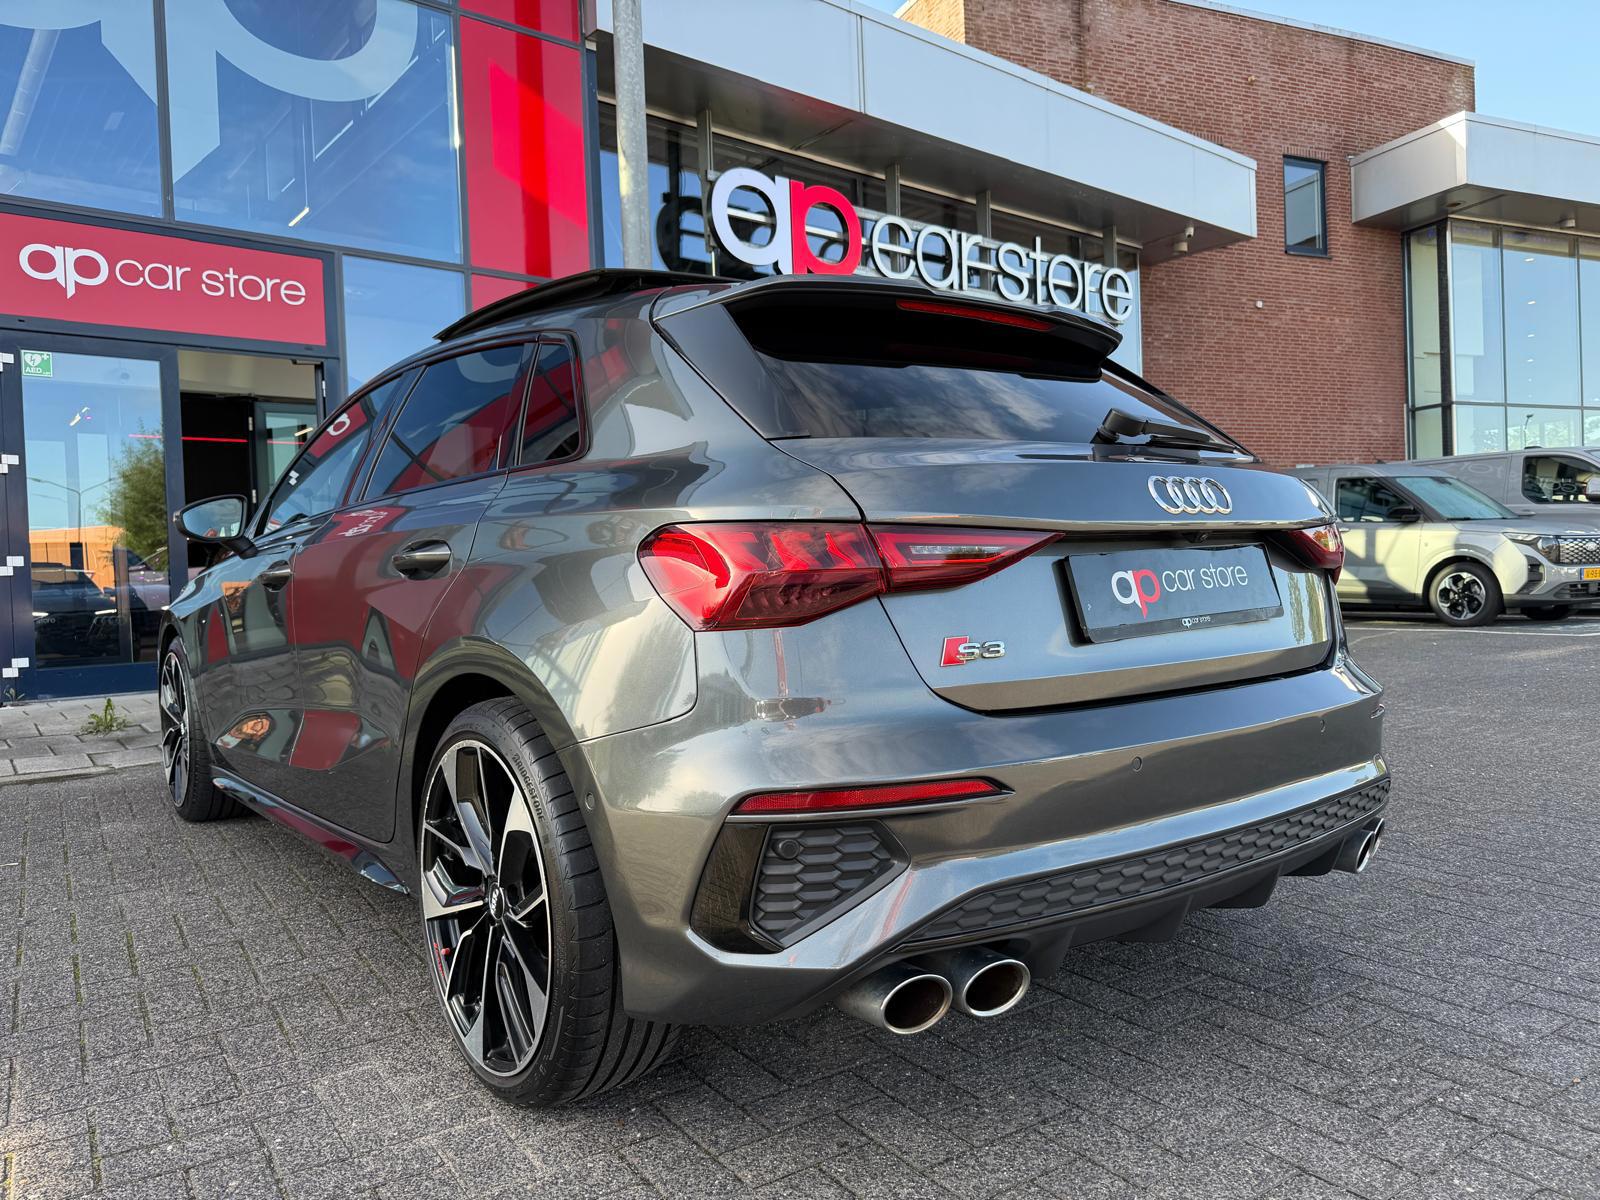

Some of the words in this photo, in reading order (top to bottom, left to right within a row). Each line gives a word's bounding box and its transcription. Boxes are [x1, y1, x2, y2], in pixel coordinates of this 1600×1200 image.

[711, 167, 863, 276] ap
[871, 214, 984, 291] car
[996, 235, 1135, 322] store
[18, 243, 110, 300] ap
[115, 258, 192, 292] car
[201, 266, 307, 306] store
[25, 366, 43, 374] AED
[1110, 568, 1162, 620] ap
[1161, 568, 1197, 593] car
[1200, 562, 1249, 590] store
[957, 640, 1006, 661] S3
[1182, 617, 1192, 629] ap
[511, 752, 546, 823] BRIDGESTONE
